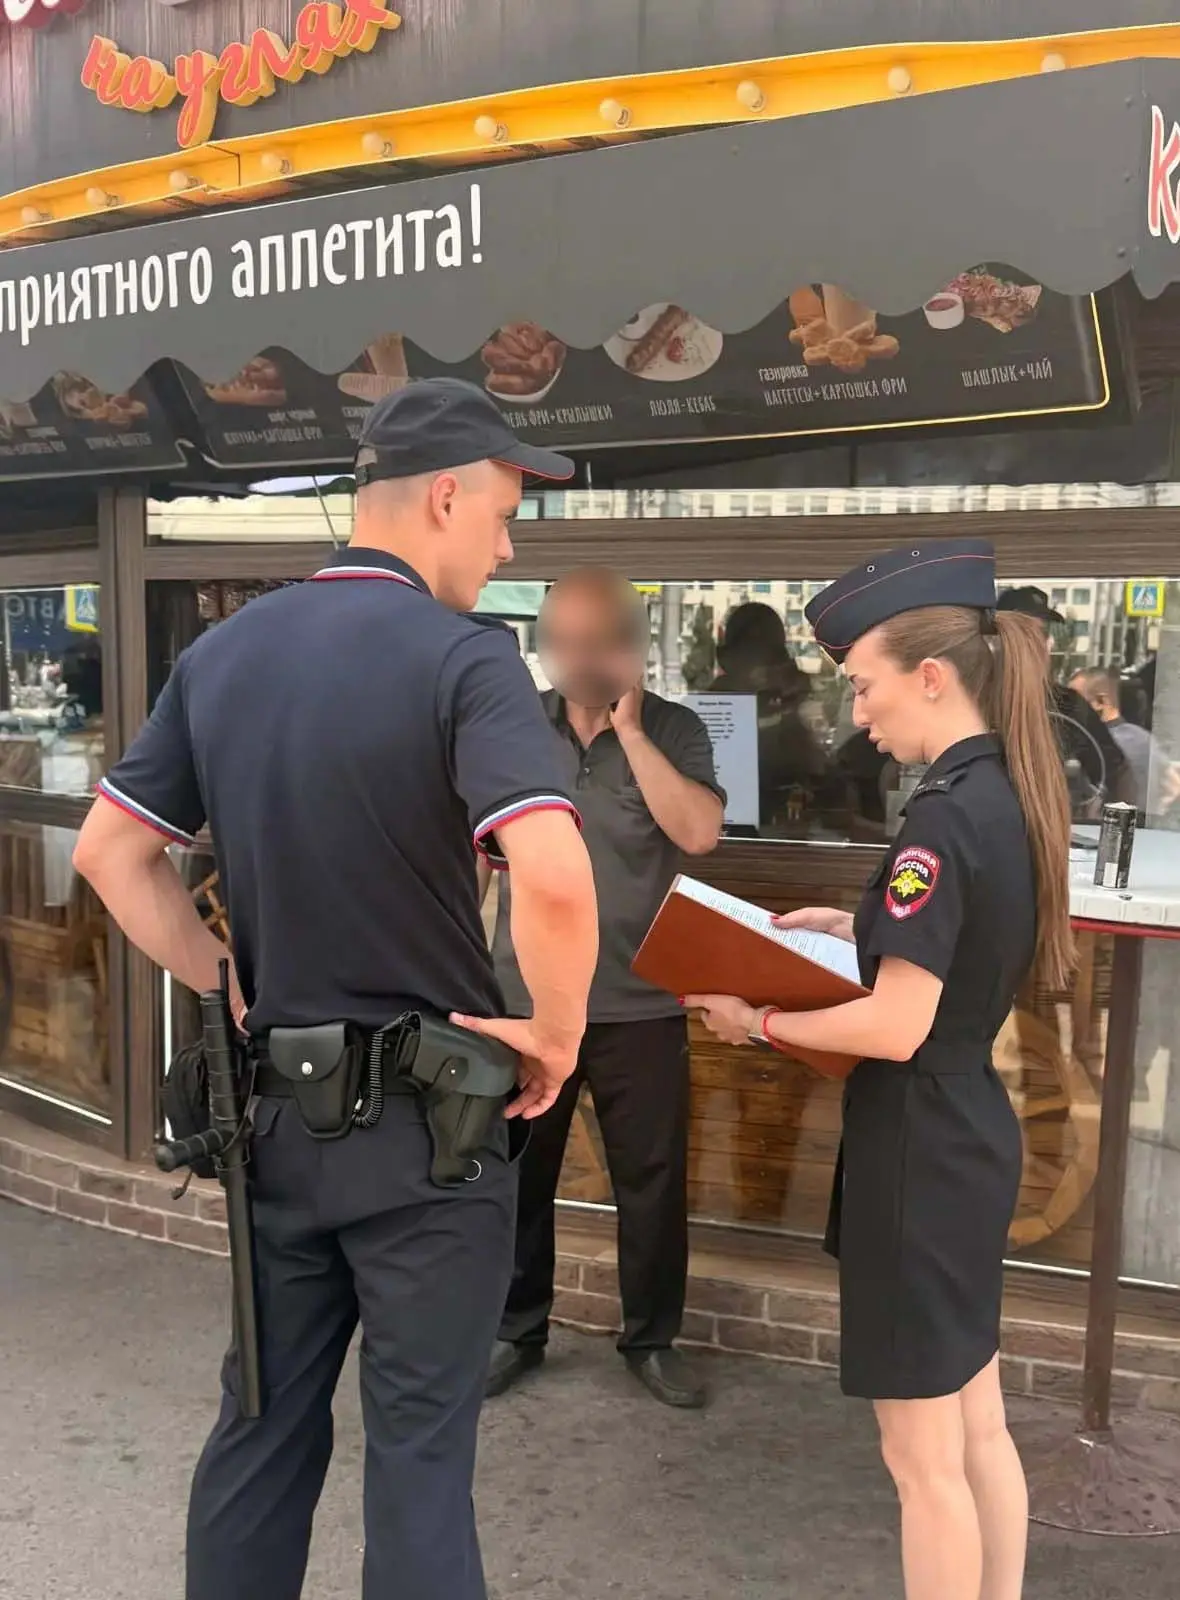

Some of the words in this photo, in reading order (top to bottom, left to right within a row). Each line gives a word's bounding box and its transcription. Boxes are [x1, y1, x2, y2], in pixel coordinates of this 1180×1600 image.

[1148, 105, 1180, 244] К
[0, 246, 213, 346] приятного
[231, 183, 483, 298] аппетита!
[881, 376, 908, 396] ФРИ
